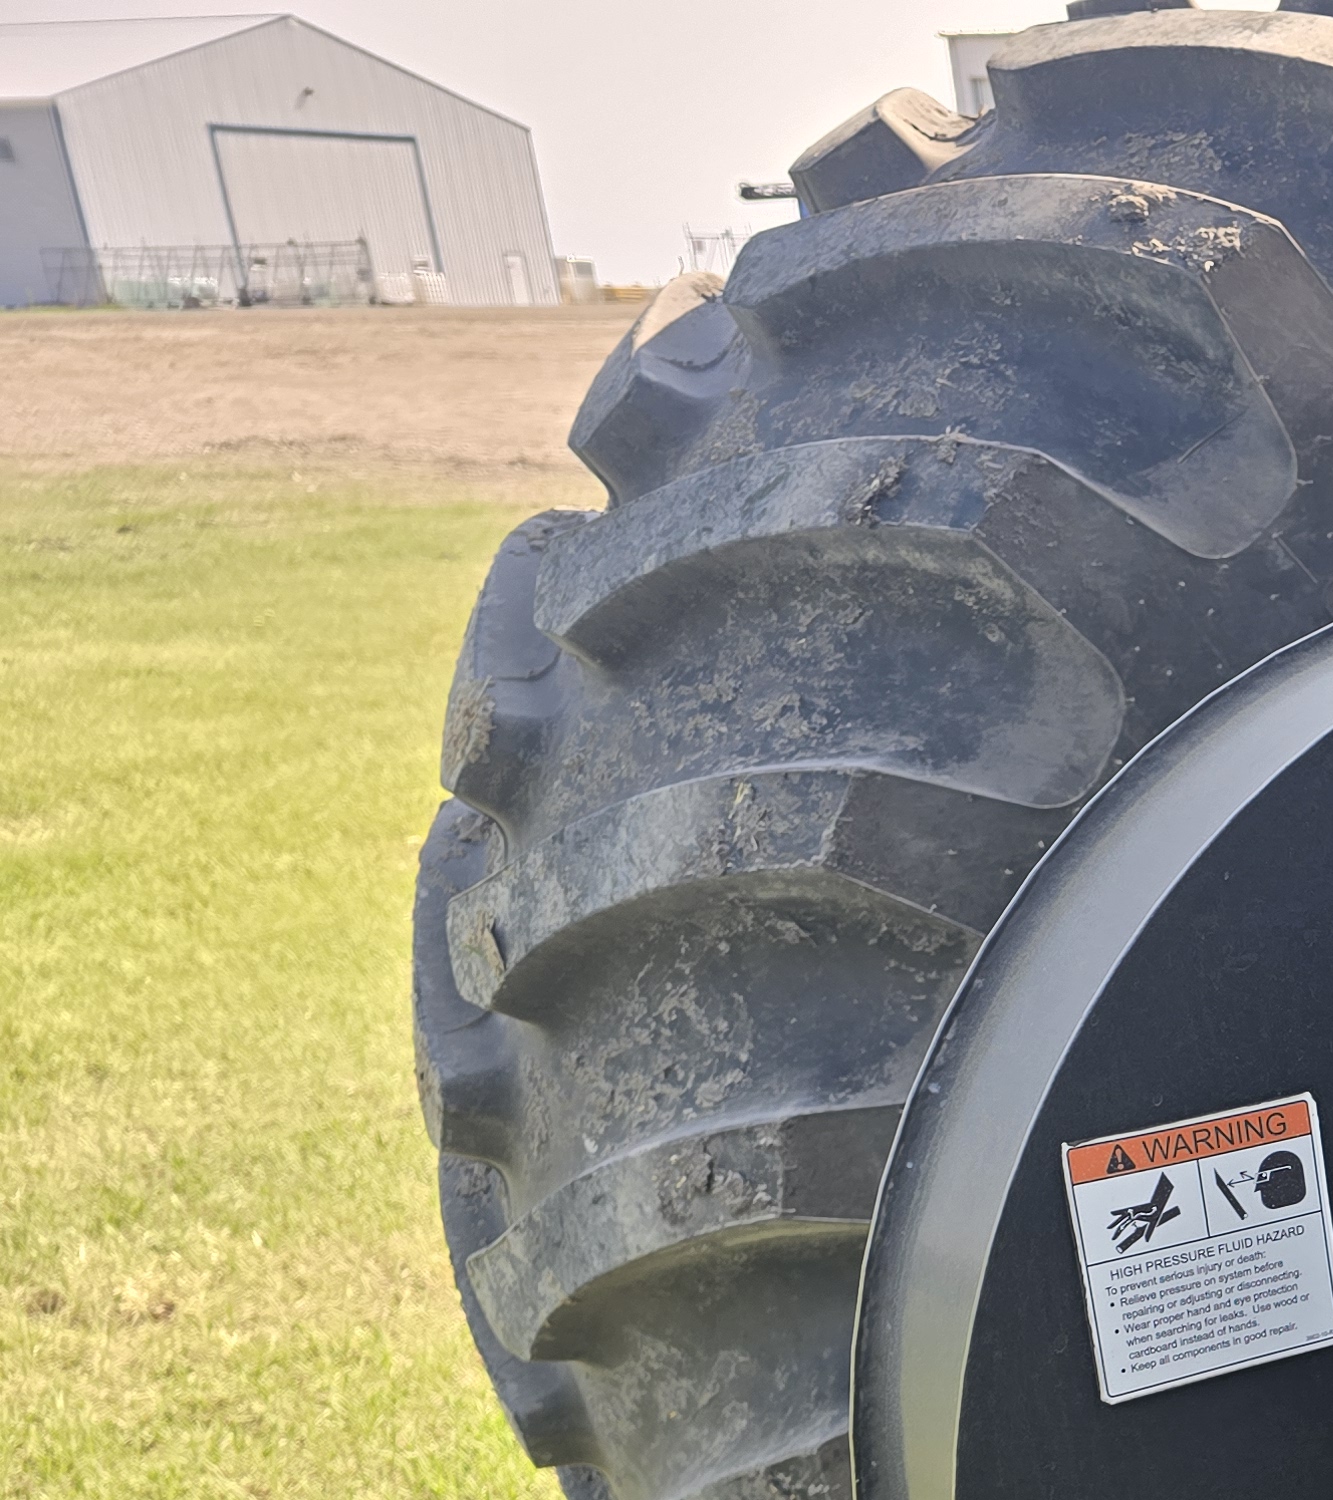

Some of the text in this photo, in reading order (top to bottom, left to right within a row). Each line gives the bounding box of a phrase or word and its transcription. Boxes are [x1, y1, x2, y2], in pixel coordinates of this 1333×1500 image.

[1142, 1112, 1287, 1163] WARNING
[1105, 1250, 1267, 1297] To prevent serious injury or death:
[1109, 1224, 1305, 1281] HIGH PRESSURE FLUID HAZARD
[1119, 1260, 1284, 1307] Relieve pressure on system before
[1121, 1268, 1303, 1321] repairing or adjusting or disconnecting.
[1123, 1282, 1298, 1334] Wear proper hand and eye protection
[1125, 1292, 1311, 1348] when searching for leaks. Use wood or
[1128, 1318, 1260, 1360] cardboard instead of hands.
[1130, 1357, 1158, 1373] Keep
[1158, 1353, 1171, 1365] all
[1171, 1339, 1231, 1363] components
[1232, 1336, 1242, 1345] in
[1243, 1328, 1267, 1345] good
[1268, 1321, 1298, 1336] repair.
